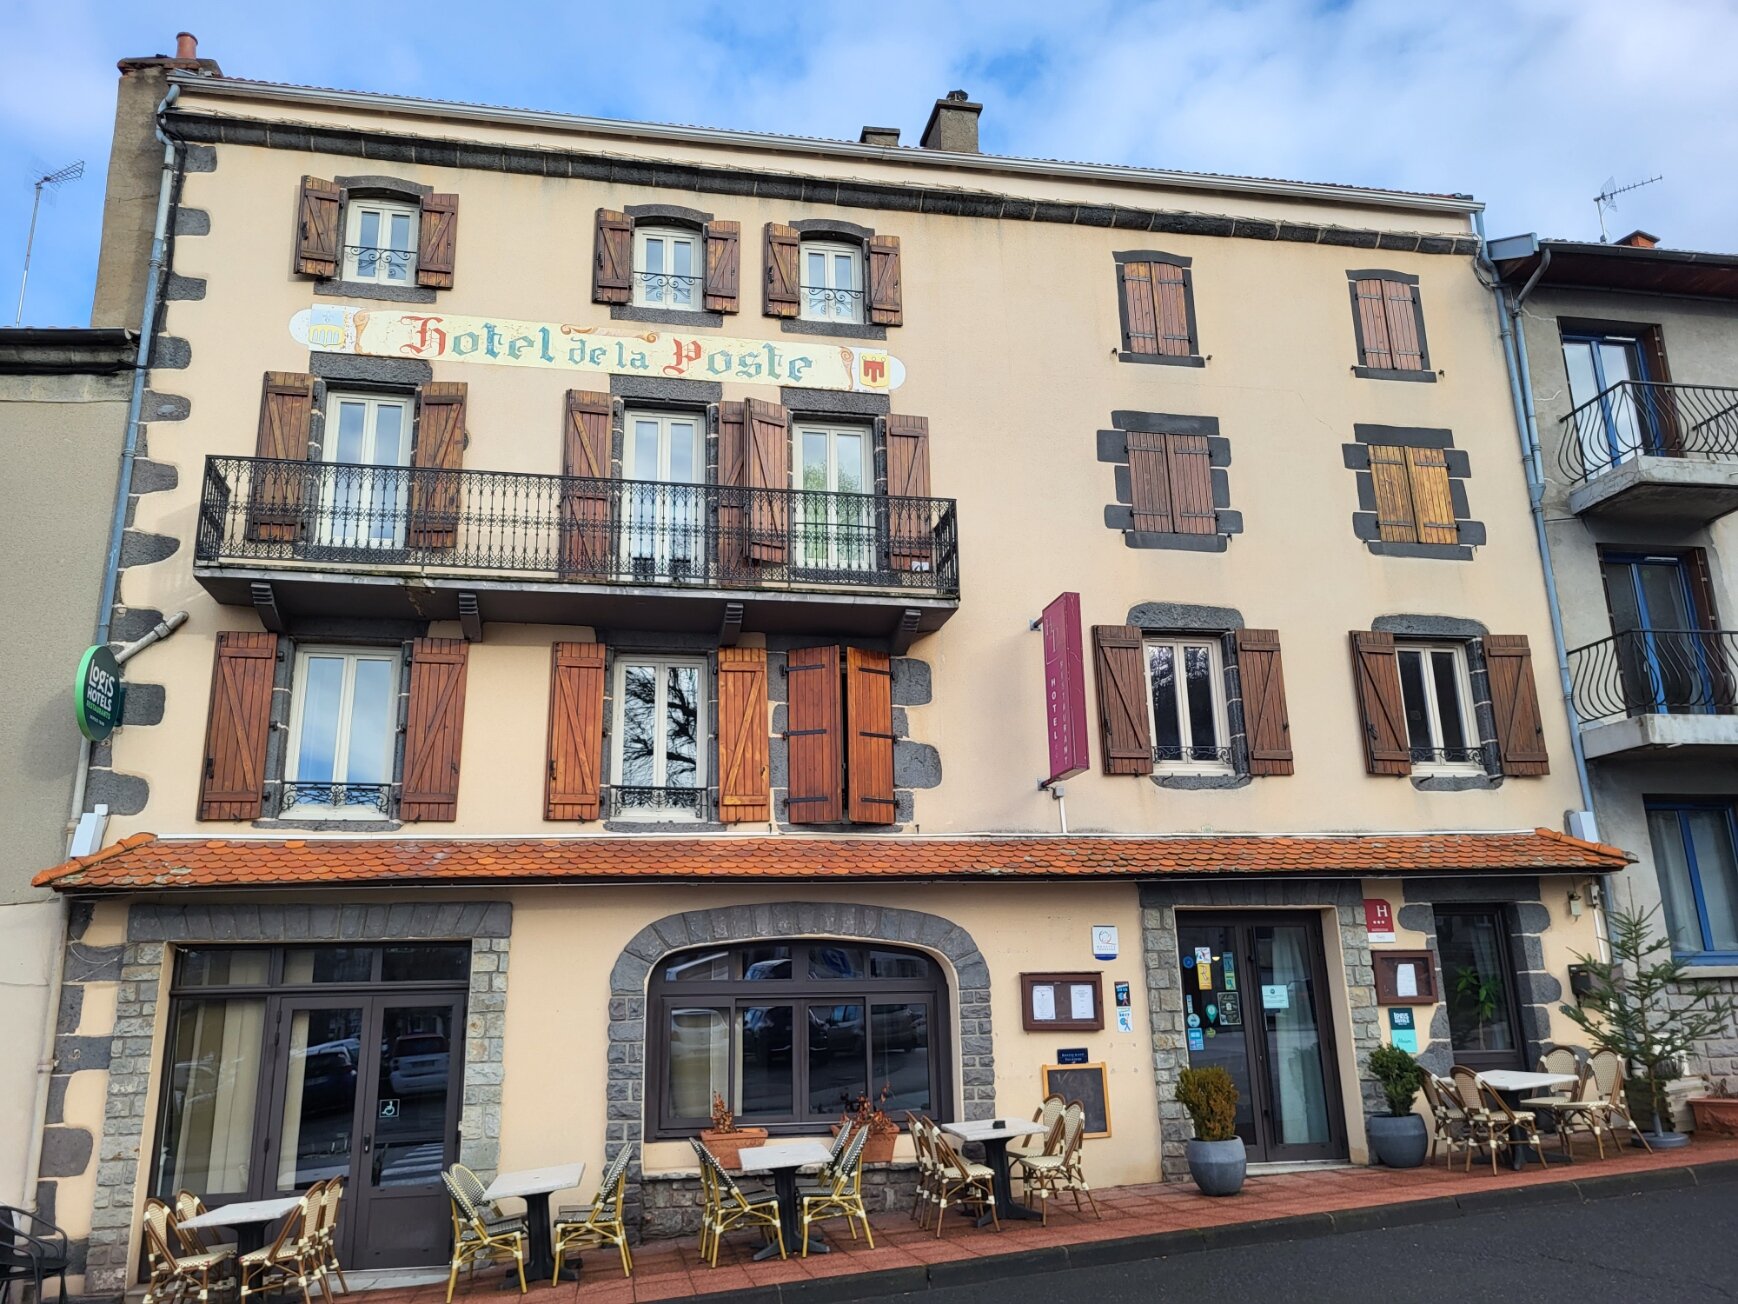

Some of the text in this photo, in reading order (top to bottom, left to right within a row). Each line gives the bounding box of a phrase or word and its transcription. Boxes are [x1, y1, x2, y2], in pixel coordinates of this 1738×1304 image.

[400, 315, 812, 383] Hotel de la Poste
[86, 685, 113, 712] HOTELS
[1050, 677, 1059, 740] HOTEL
[1376, 905, 1388, 917] H
